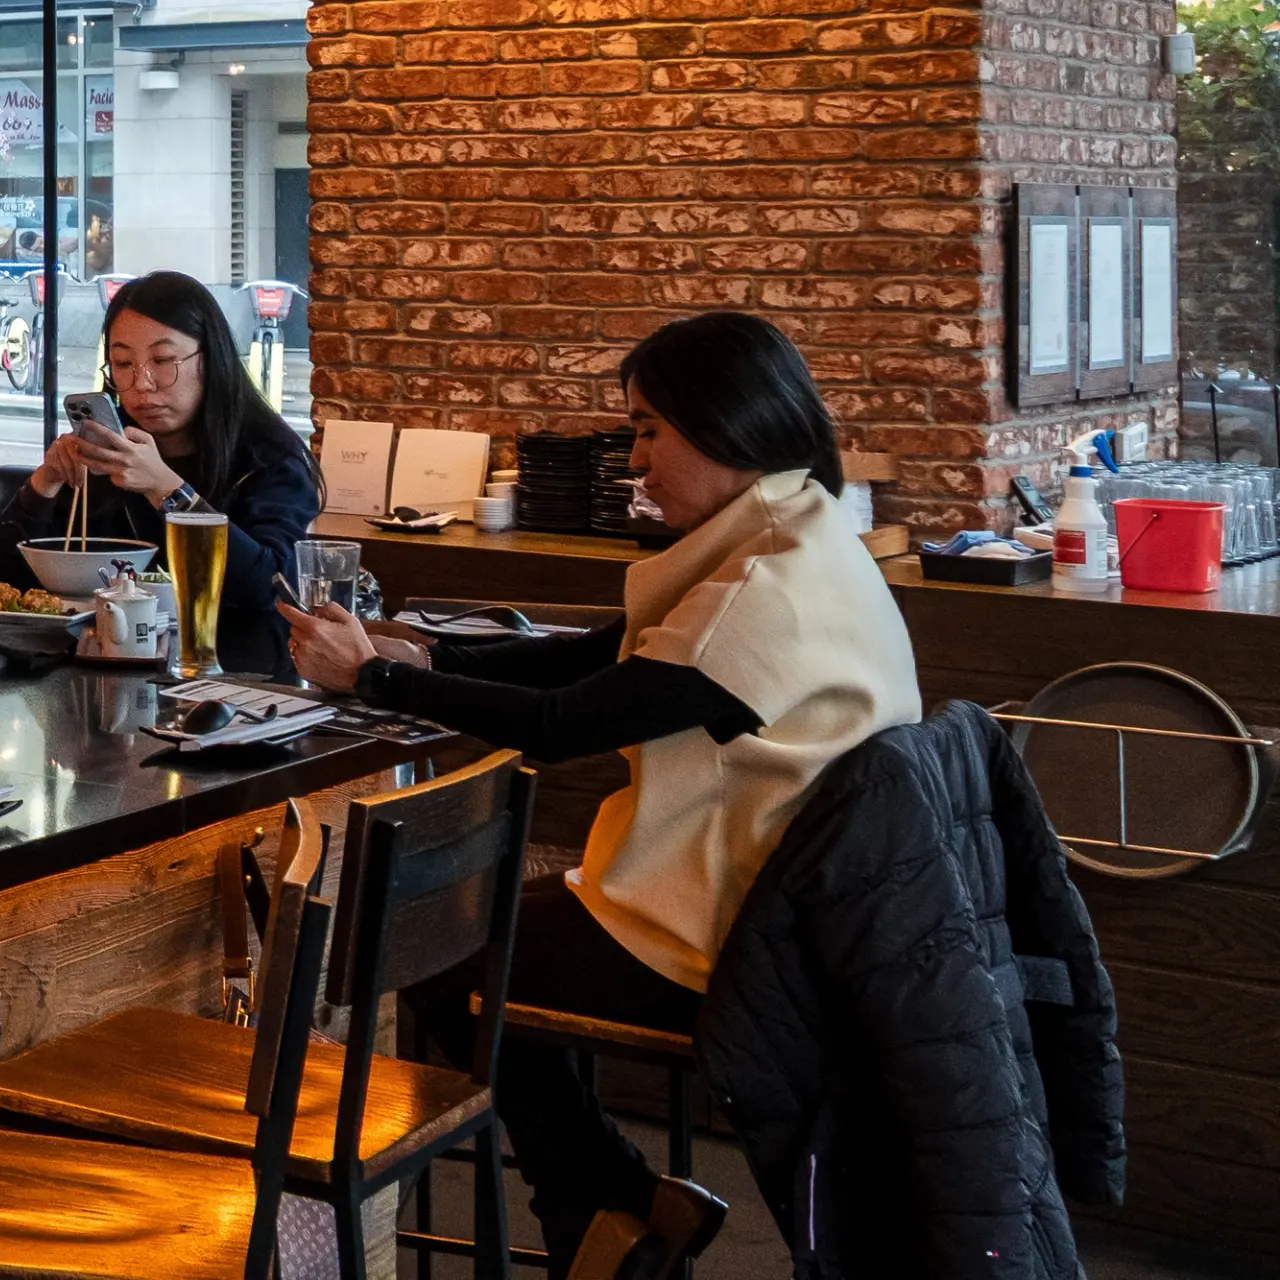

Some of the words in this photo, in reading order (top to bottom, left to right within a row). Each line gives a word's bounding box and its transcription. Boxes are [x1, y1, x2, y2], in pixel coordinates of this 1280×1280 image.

[3, 90, 44, 109] Mass
[89, 88, 114, 105] Facia
[341, 450, 368, 461] WHY
